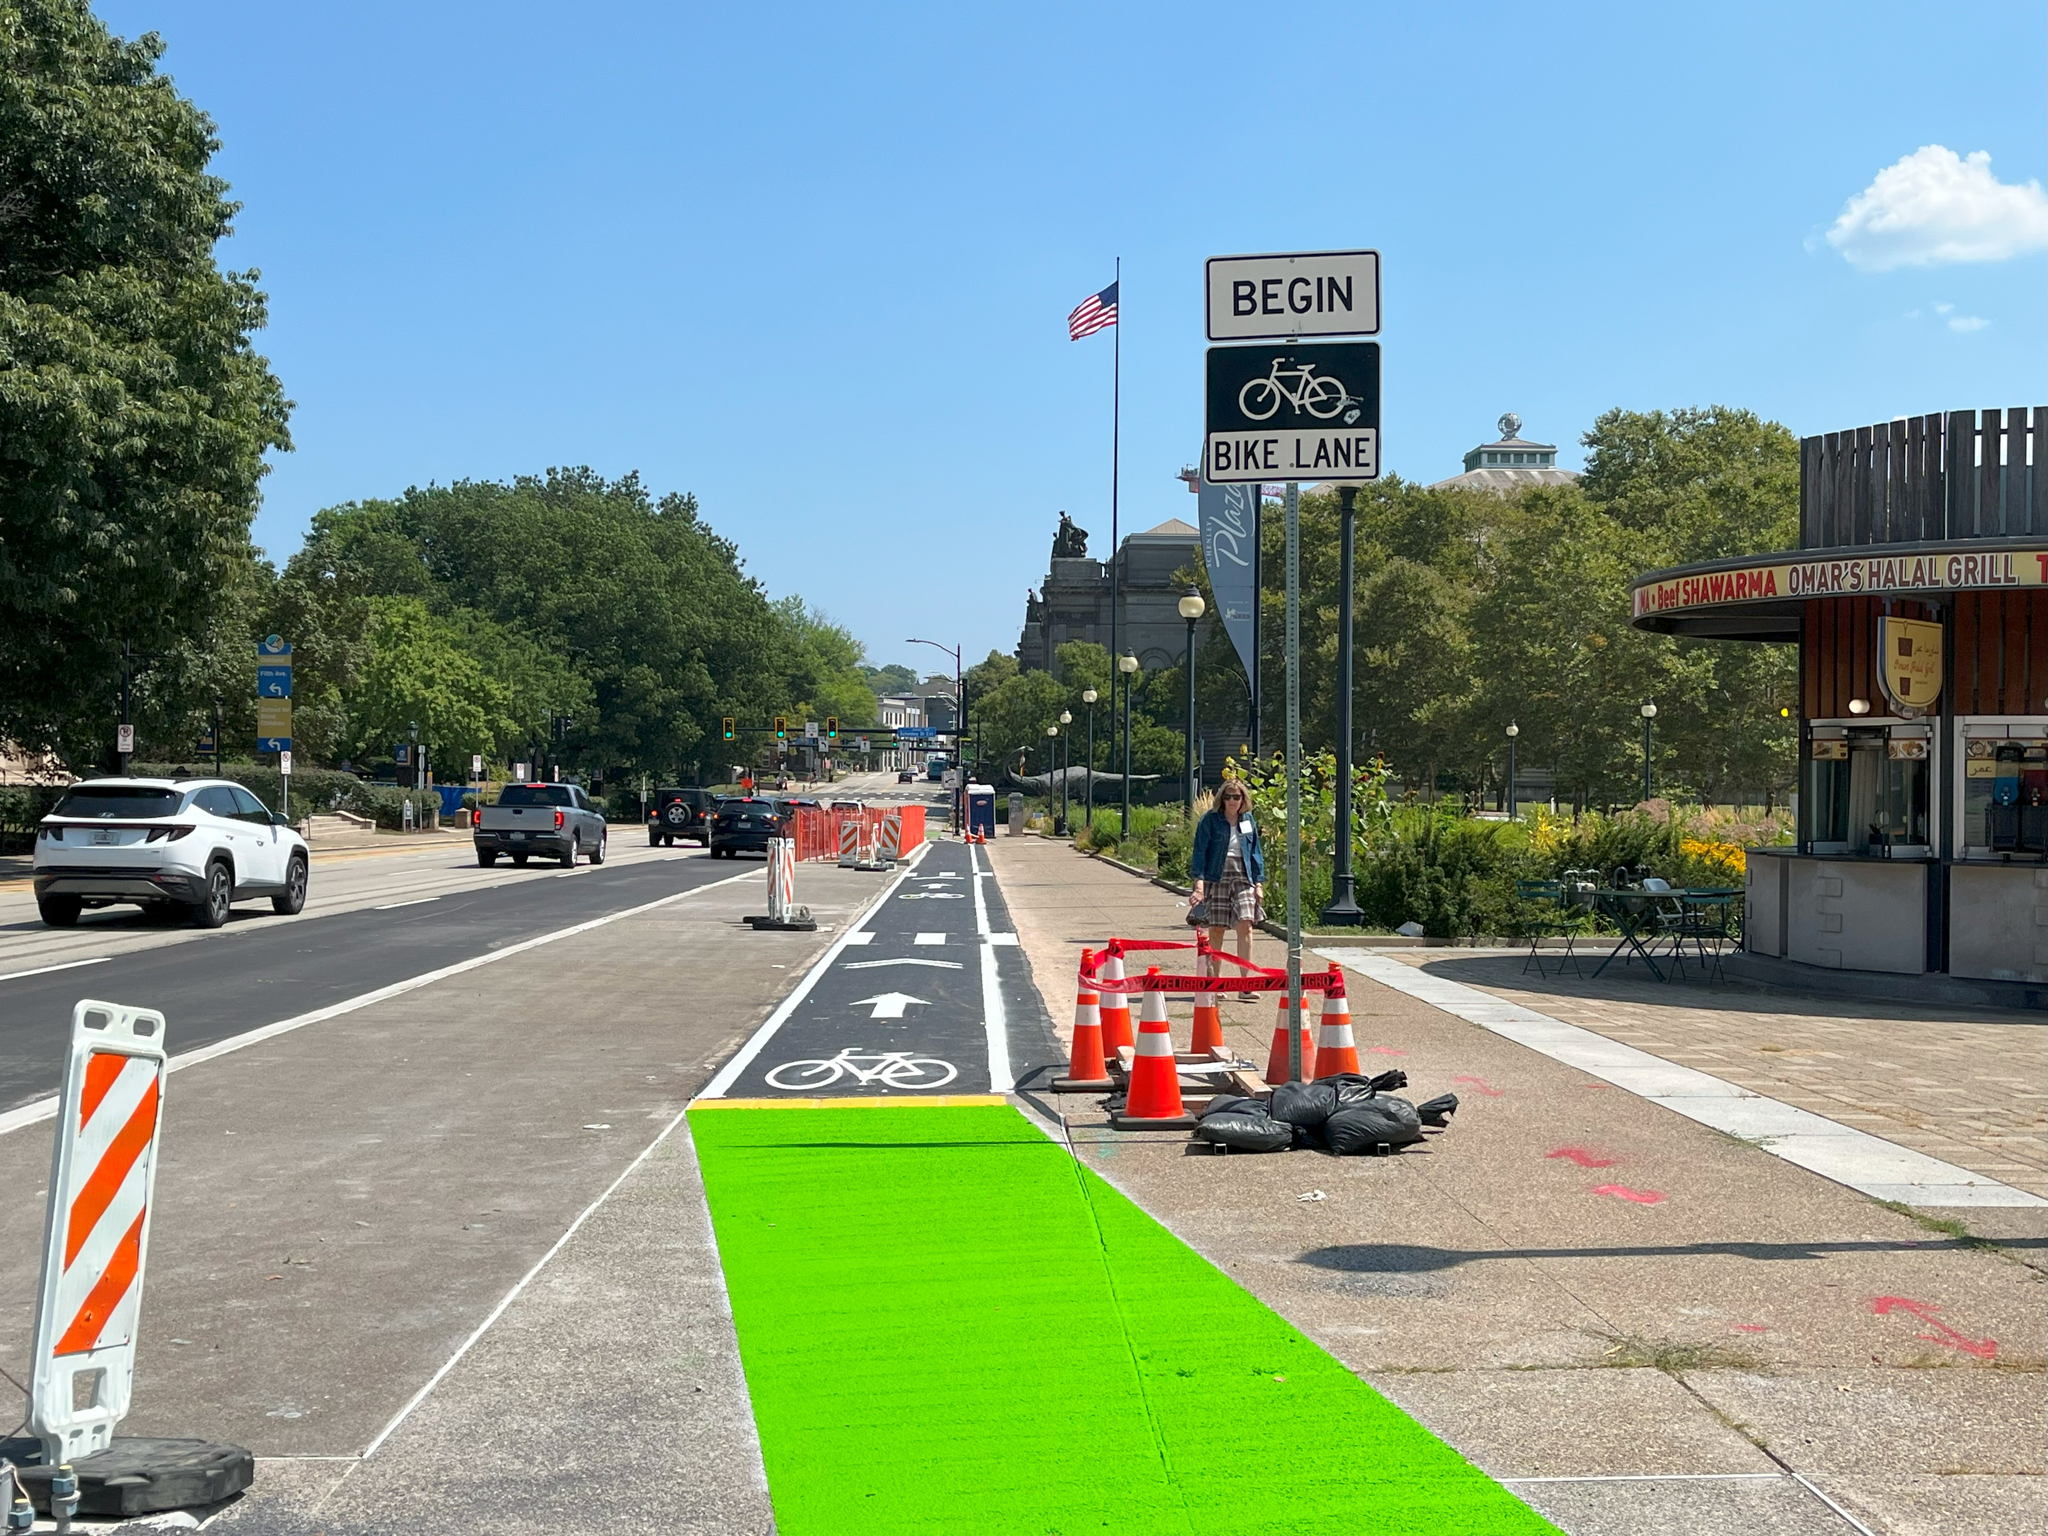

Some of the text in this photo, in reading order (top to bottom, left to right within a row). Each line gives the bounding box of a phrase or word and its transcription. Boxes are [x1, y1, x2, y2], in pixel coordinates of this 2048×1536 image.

[1232, 275, 1353, 317] BEGIN
[1214, 437, 1371, 471] BIKE LANE
[1657, 581, 1681, 609] Beef
[1682, 569, 1778, 606] SHAWARMA
[1788, 554, 2017, 595] OMAR'S HALAL GRILL
[1158, 977, 1206, 990] PELIGRO
[1223, 977, 1266, 989] DANGER
